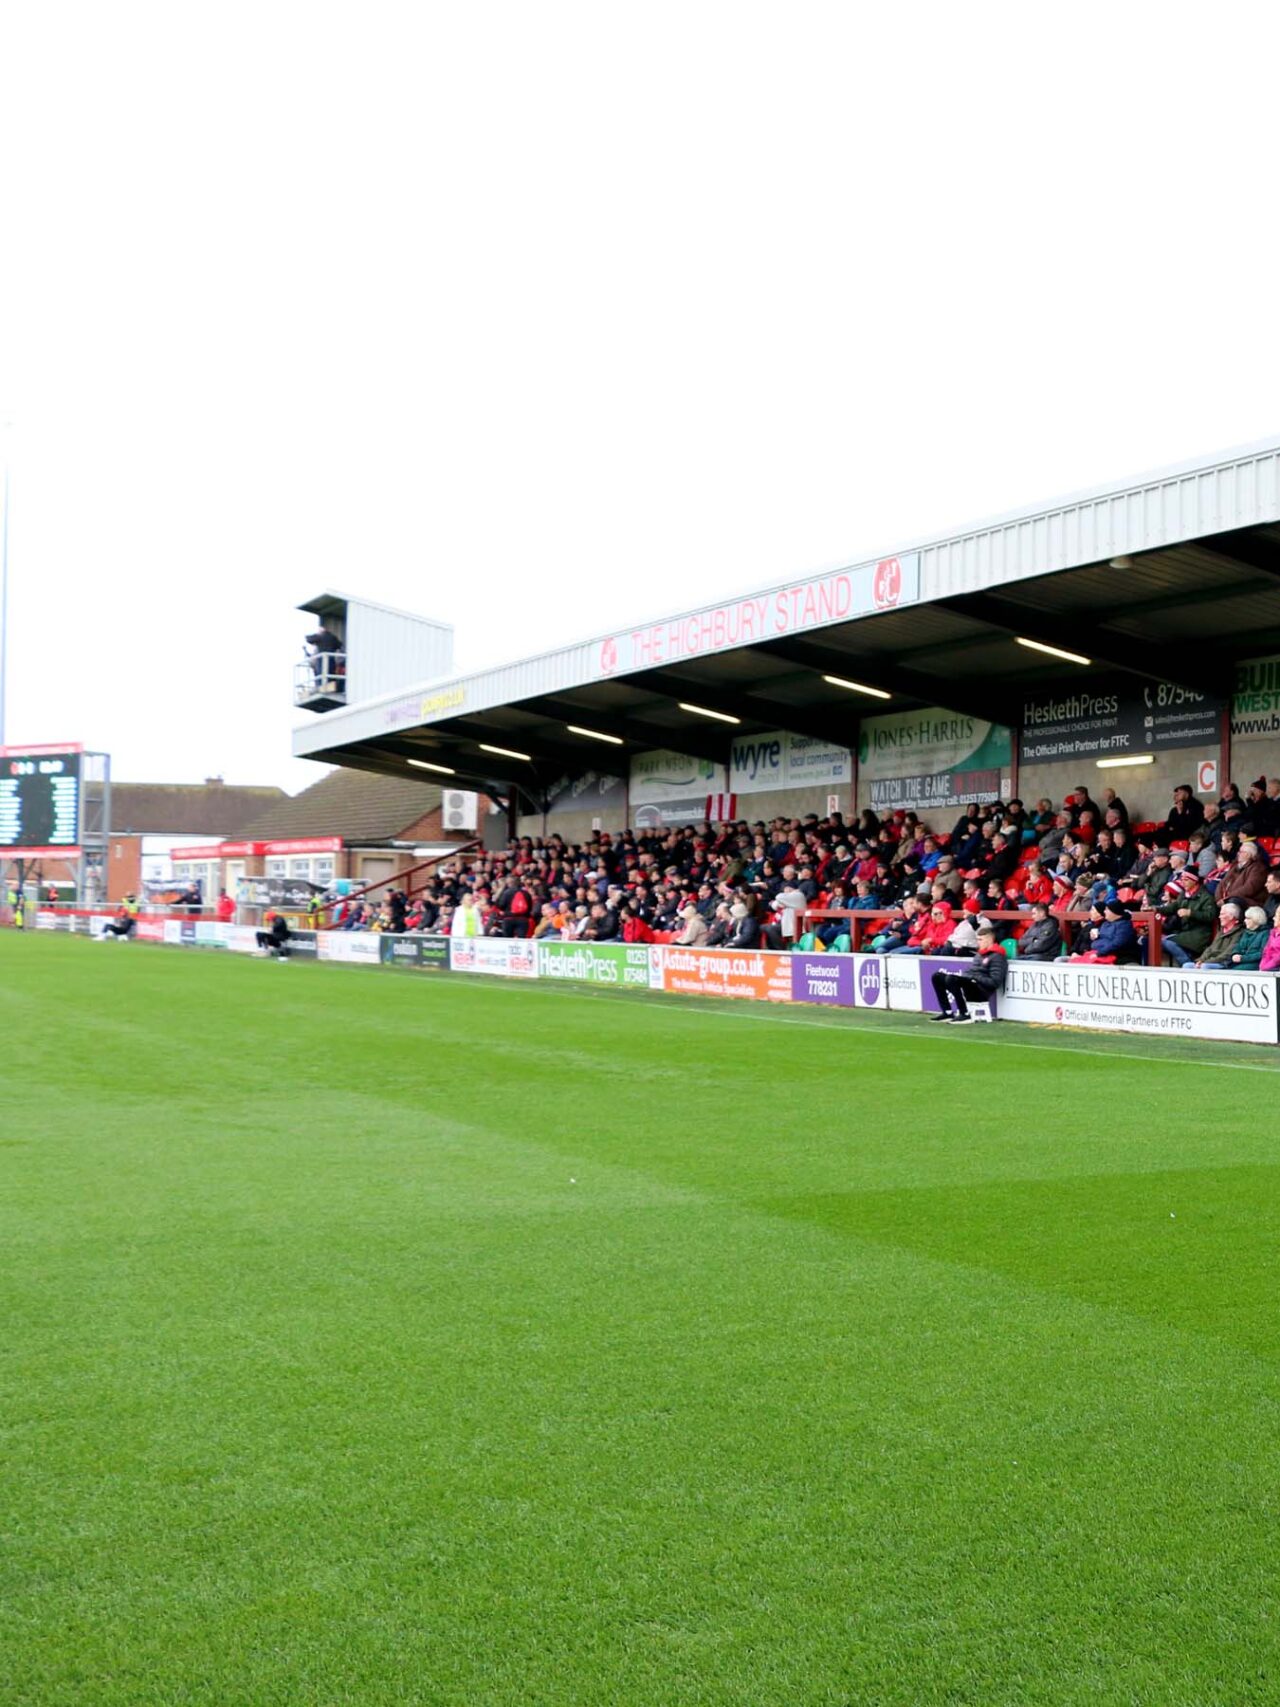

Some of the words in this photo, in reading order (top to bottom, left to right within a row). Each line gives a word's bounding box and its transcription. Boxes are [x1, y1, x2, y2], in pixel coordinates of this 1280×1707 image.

[631, 626, 664, 668] THE
[669, 598, 770, 656] HIGHBURY
[776, 575, 852, 633] STAND
[1023, 693, 1118, 725] HeskethPress
[1111, 734, 1130, 747] FTFC
[733, 740, 780, 780] wyre
[871, 778, 901, 801] WATCH
[906, 777, 921, 798] THE
[925, 775, 950, 797] GAME
[1200, 762, 1215, 790] C
[539, 948, 617, 982] HeskethPress
[663, 948, 764, 979] Astute-group.co.uk
[805, 963, 840, 978] Fleetwood
[807, 980, 837, 997] 778231
[881, 977, 917, 990] Solicitors
[1077, 974, 1153, 1002] FUNERAL
[1158, 978, 1270, 1010] DIRECTORS
[1065, 1009, 1089, 1022] Official
[1091, 1011, 1125, 1025] Memorial
[1126, 1012, 1159, 1027] Partners
[1161, 1014, 1169, 1027] of
[1170, 1018, 1192, 1030] FTFC
